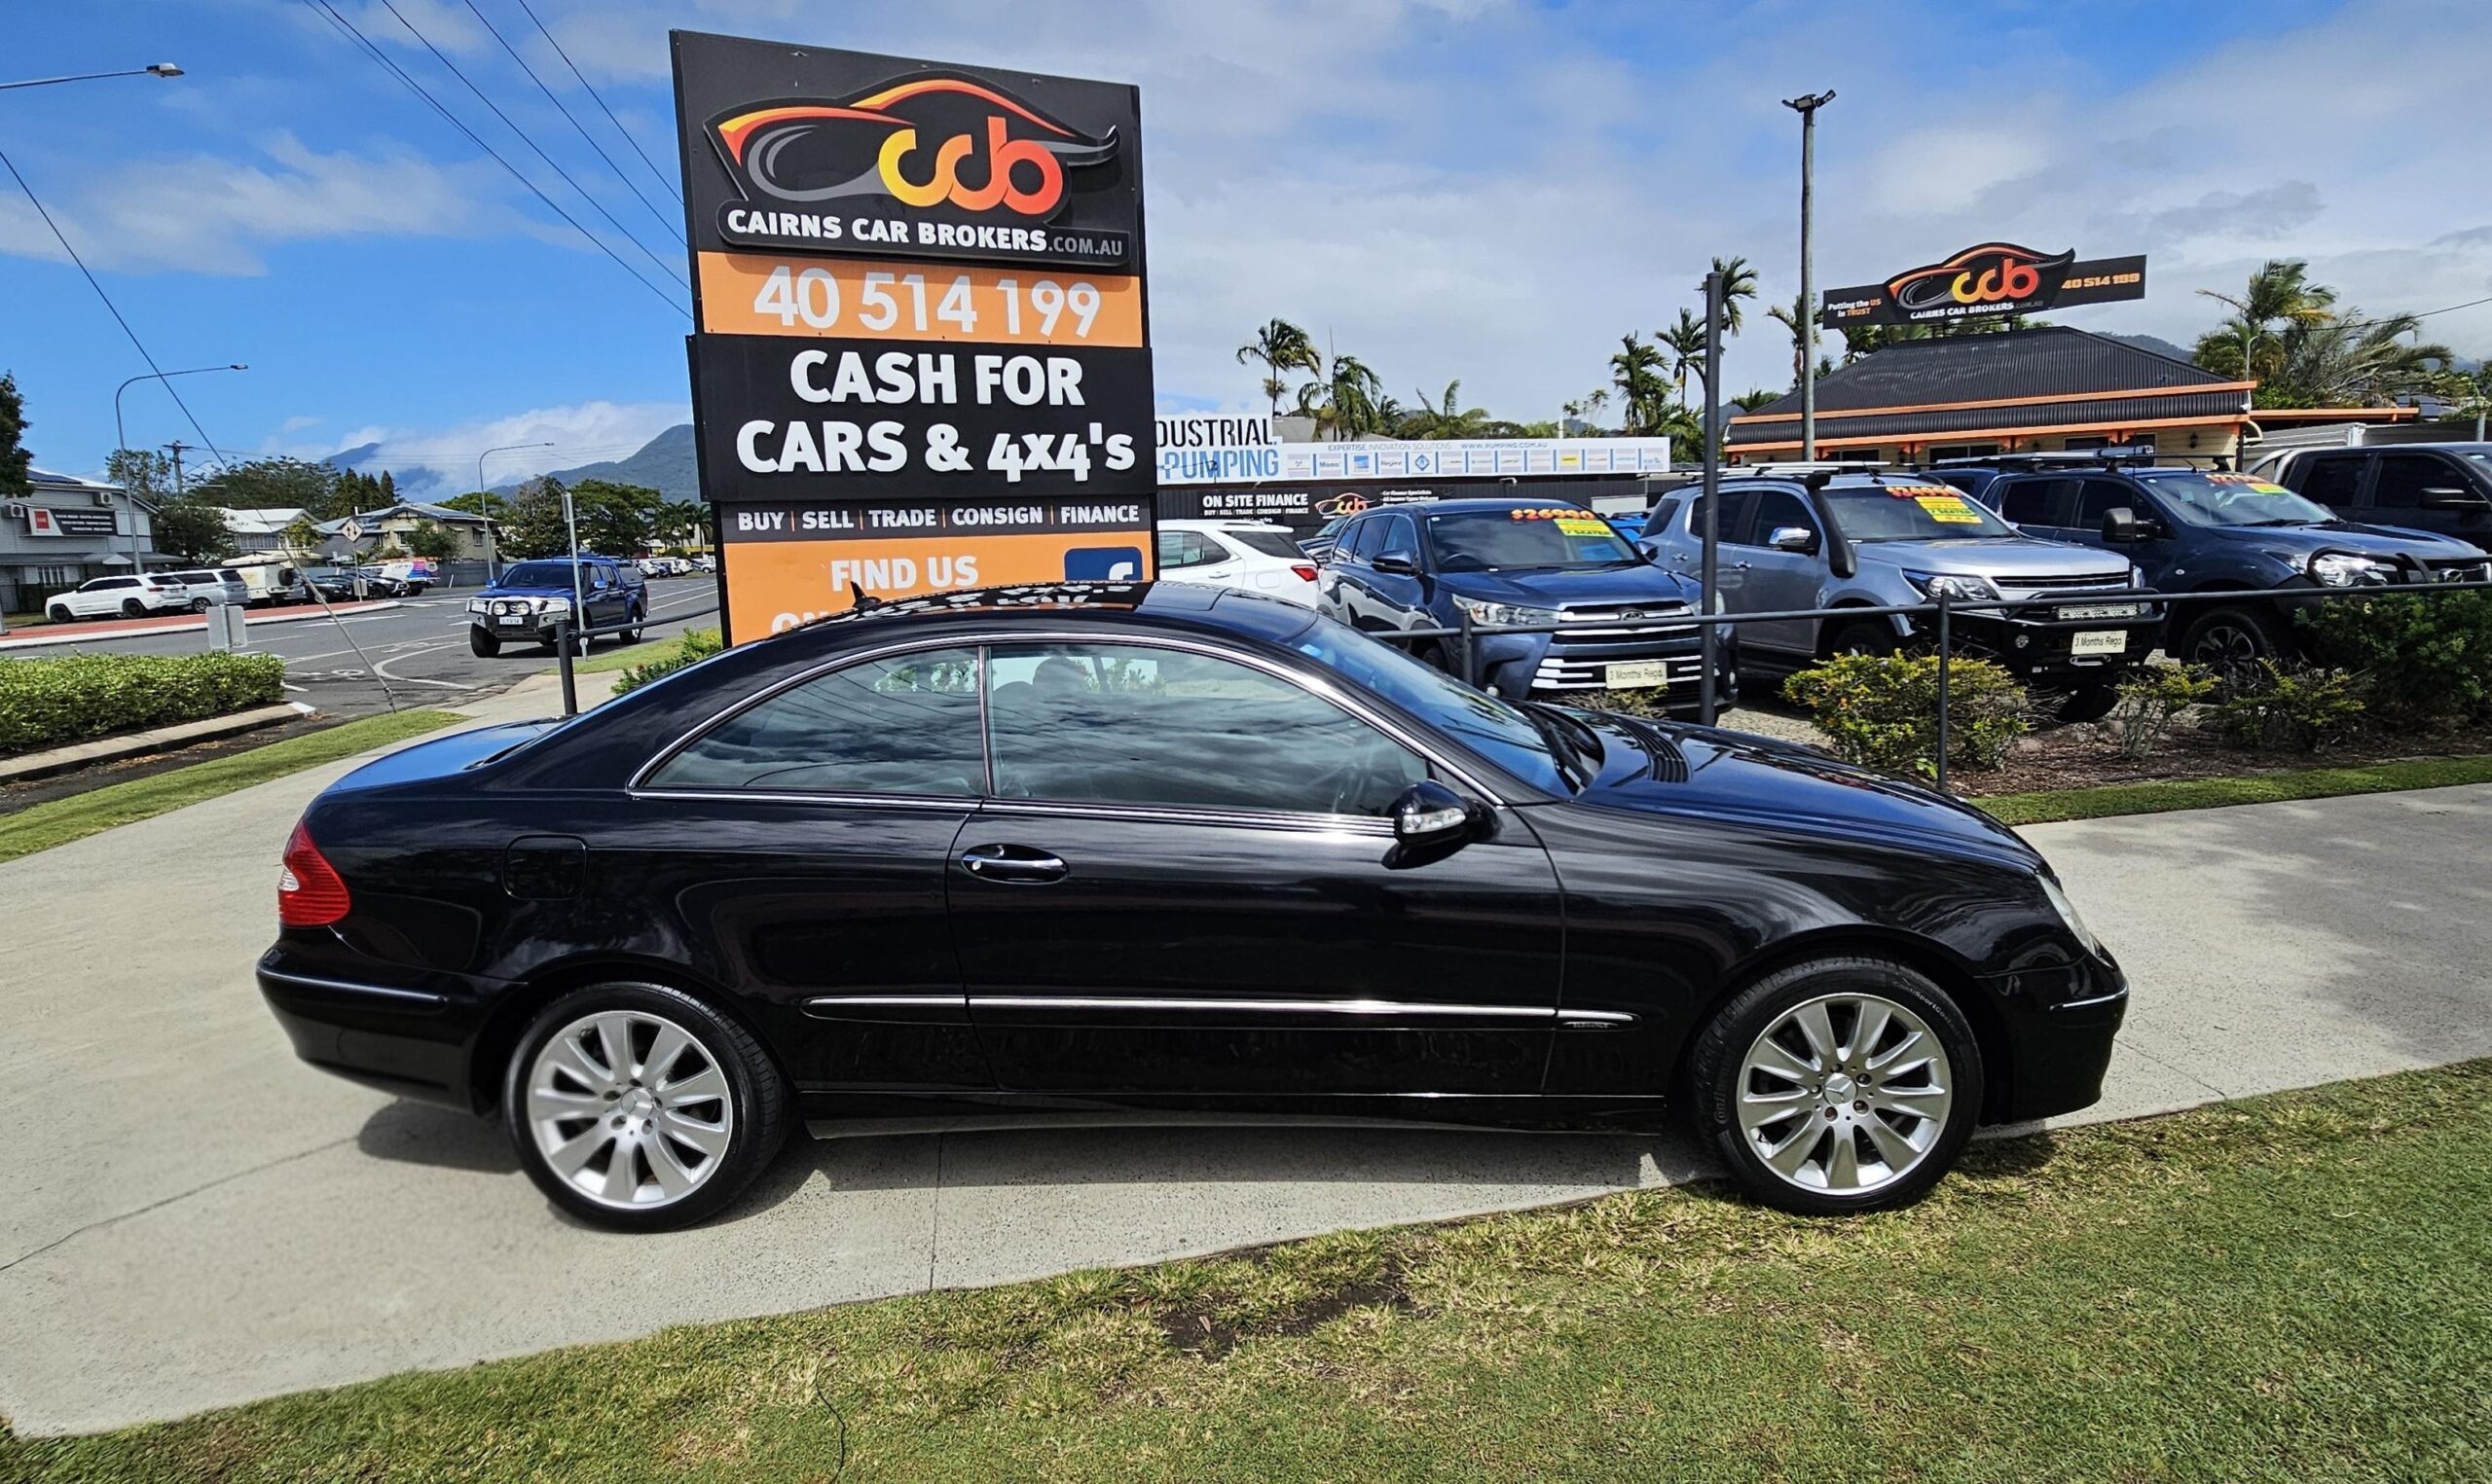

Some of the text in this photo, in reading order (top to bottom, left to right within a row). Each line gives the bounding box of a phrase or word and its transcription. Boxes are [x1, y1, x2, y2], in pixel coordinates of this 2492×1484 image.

[727, 209, 841, 240] CAIRNS
[852, 217, 908, 243] CAR
[2062, 279, 2082, 289] 40
[2083, 276, 2110, 287] 514
[753, 265, 1101, 339] 40 514 199
[1828, 302, 1855, 310] Putting
[1870, 298, 1882, 307] US
[1847, 308, 1871, 316] TRUST
[1910, 308, 1945, 319] CAIRNS
[1947, 307, 1966, 316] CAR
[790, 349, 1085, 407] CASH FOR
[737, 419, 907, 473] CARS
[925, 422, 973, 472] &
[1411, 442, 1451, 451] SOLUTIONS
[1163, 449, 1279, 479] PUMPING
[1202, 493, 1308, 507] ON SITE FINANCE
[738, 504, 1140, 531] BUY SELL TRADE CONSIGN FINANCE
[1511, 509, 1595, 520] $26990
[830, 556, 979, 592] FIND US
[2081, 636, 2104, 646] Months
